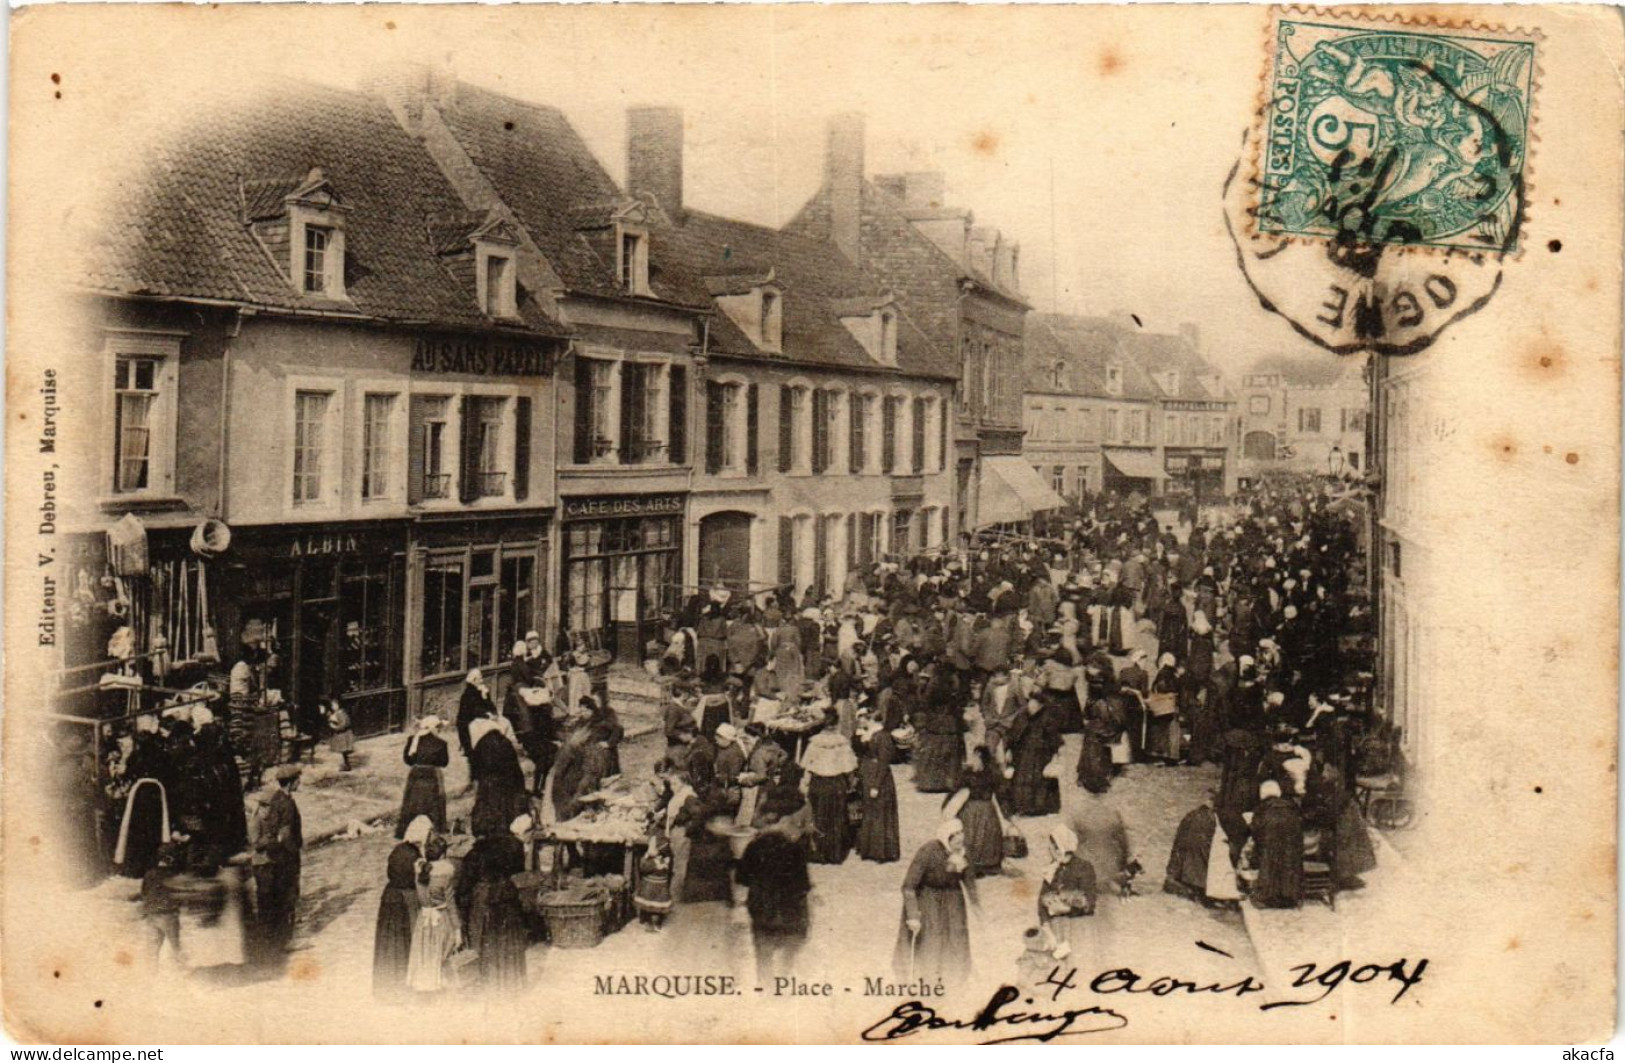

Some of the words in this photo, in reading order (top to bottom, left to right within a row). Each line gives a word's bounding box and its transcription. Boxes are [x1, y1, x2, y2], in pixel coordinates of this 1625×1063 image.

[1271, 78, 1299, 172] POSTES
[1313, 114, 1375, 150] 5
[410, 339, 435, 372] AU
[438, 341, 488, 375] SANS
[613, 499, 640, 513] DES
[646, 497, 680, 511] ARTS
[1035, 965, 1077, 1001] 4
